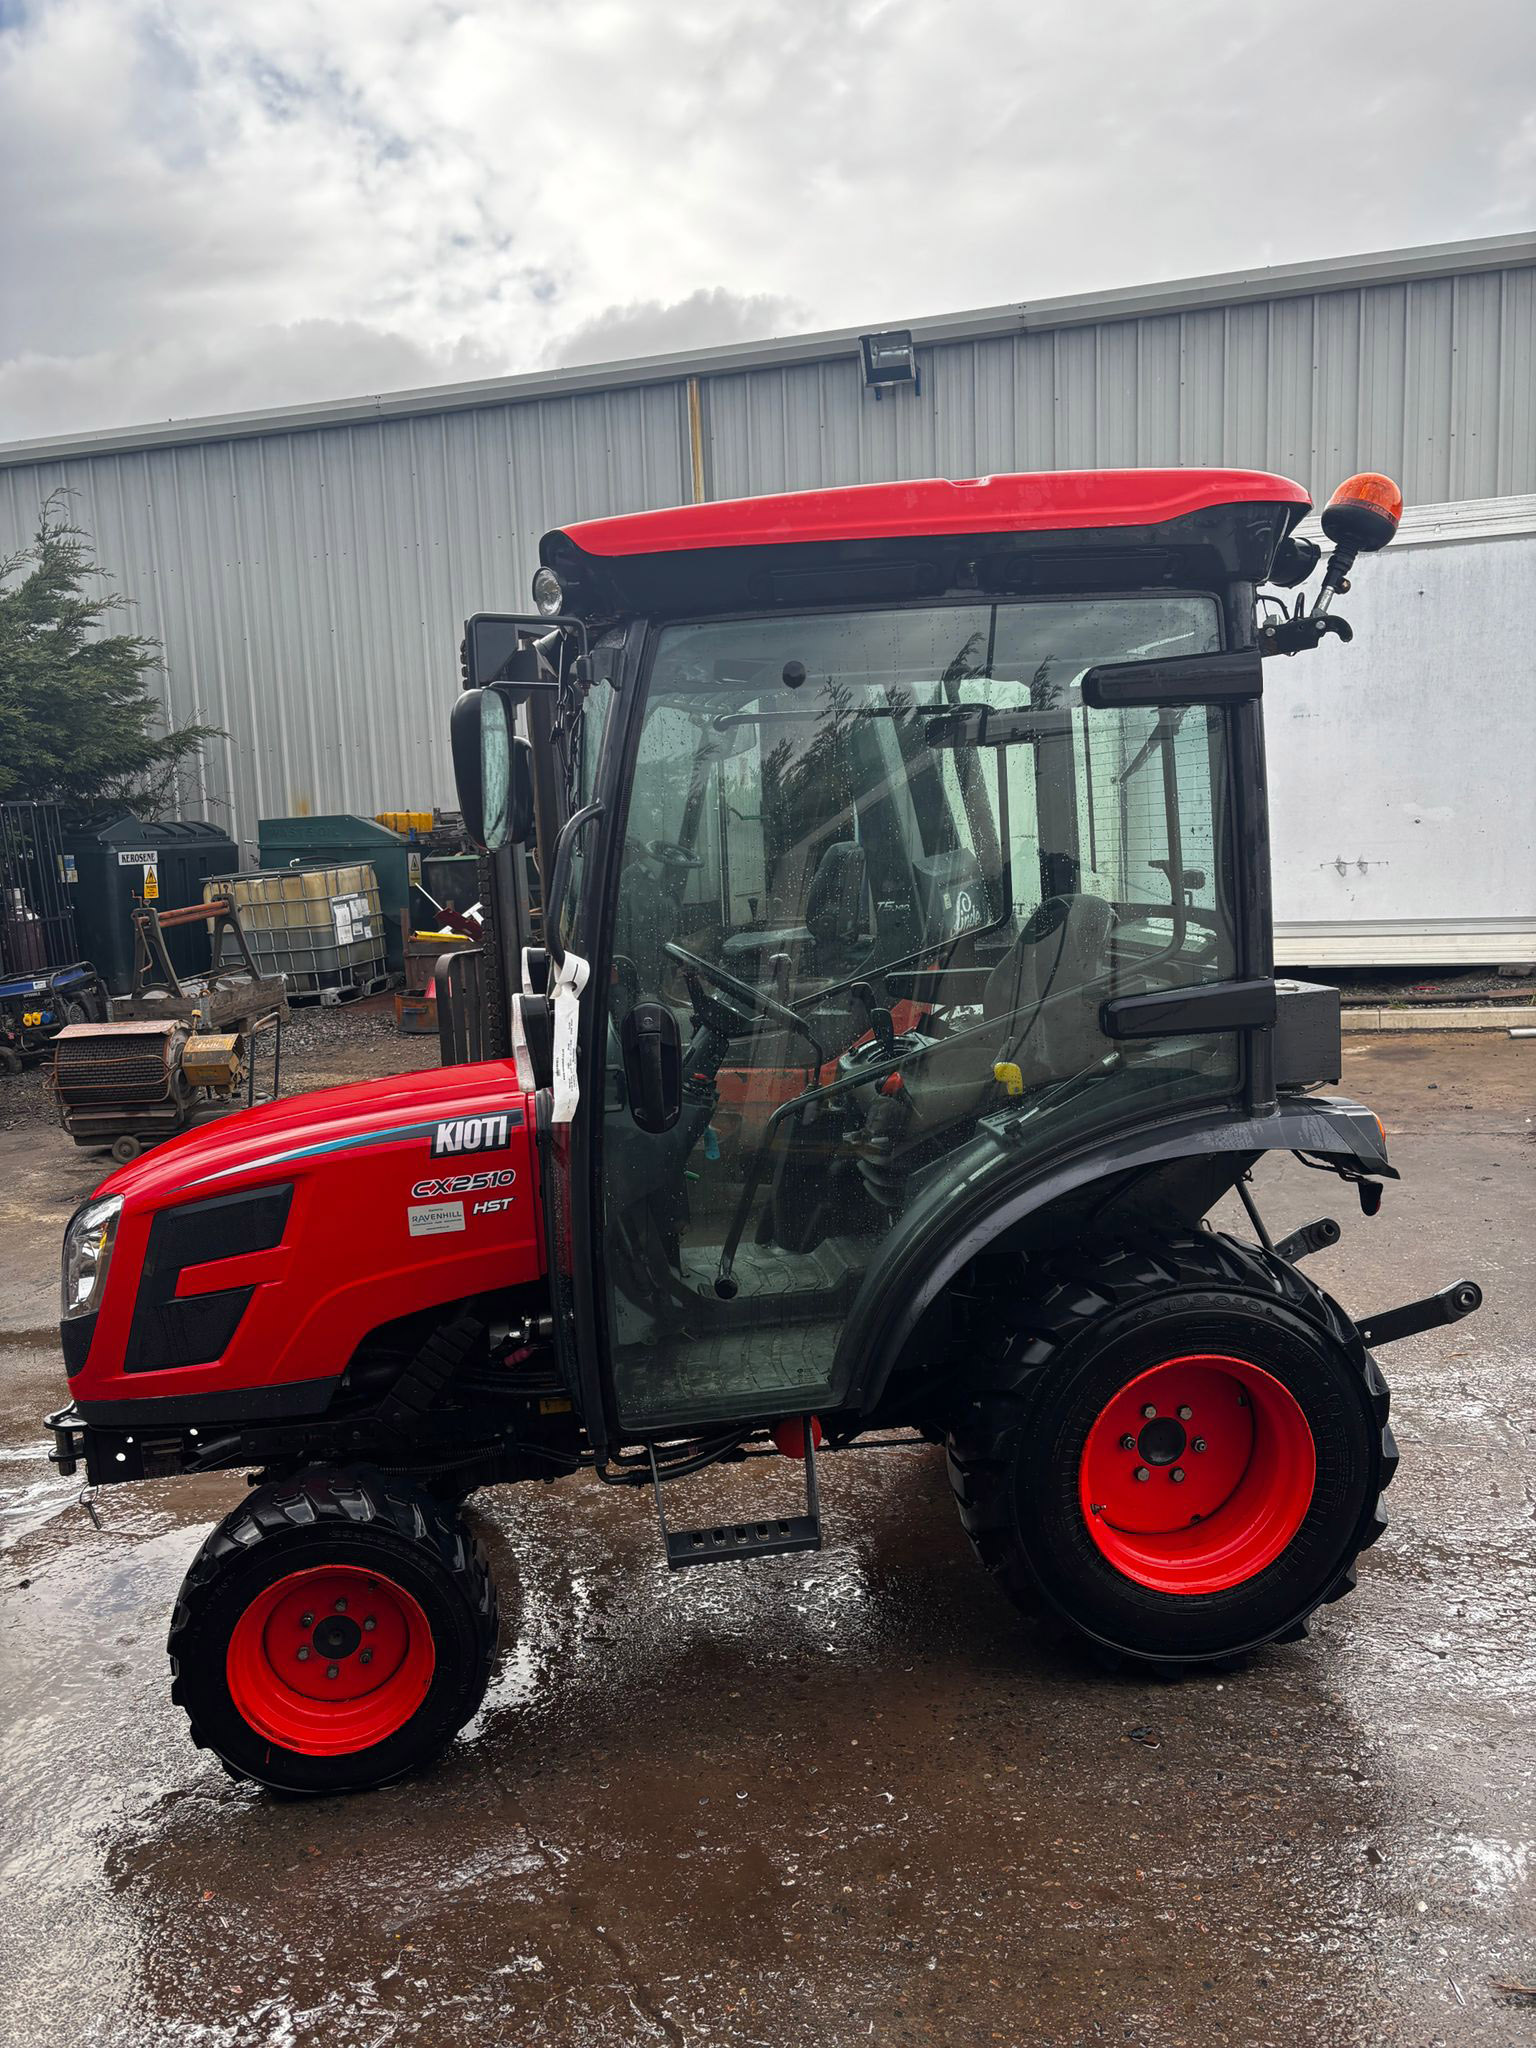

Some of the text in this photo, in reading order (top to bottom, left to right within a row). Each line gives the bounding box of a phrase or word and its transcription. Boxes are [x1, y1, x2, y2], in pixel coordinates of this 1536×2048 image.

[121, 853, 156, 863] KEROSENE
[436, 1115, 507, 1153] KIOTI
[411, 1168, 516, 1198] CX2510
[473, 1197, 514, 1215] HST
[411, 1211, 462, 1223] RAVENHILL
